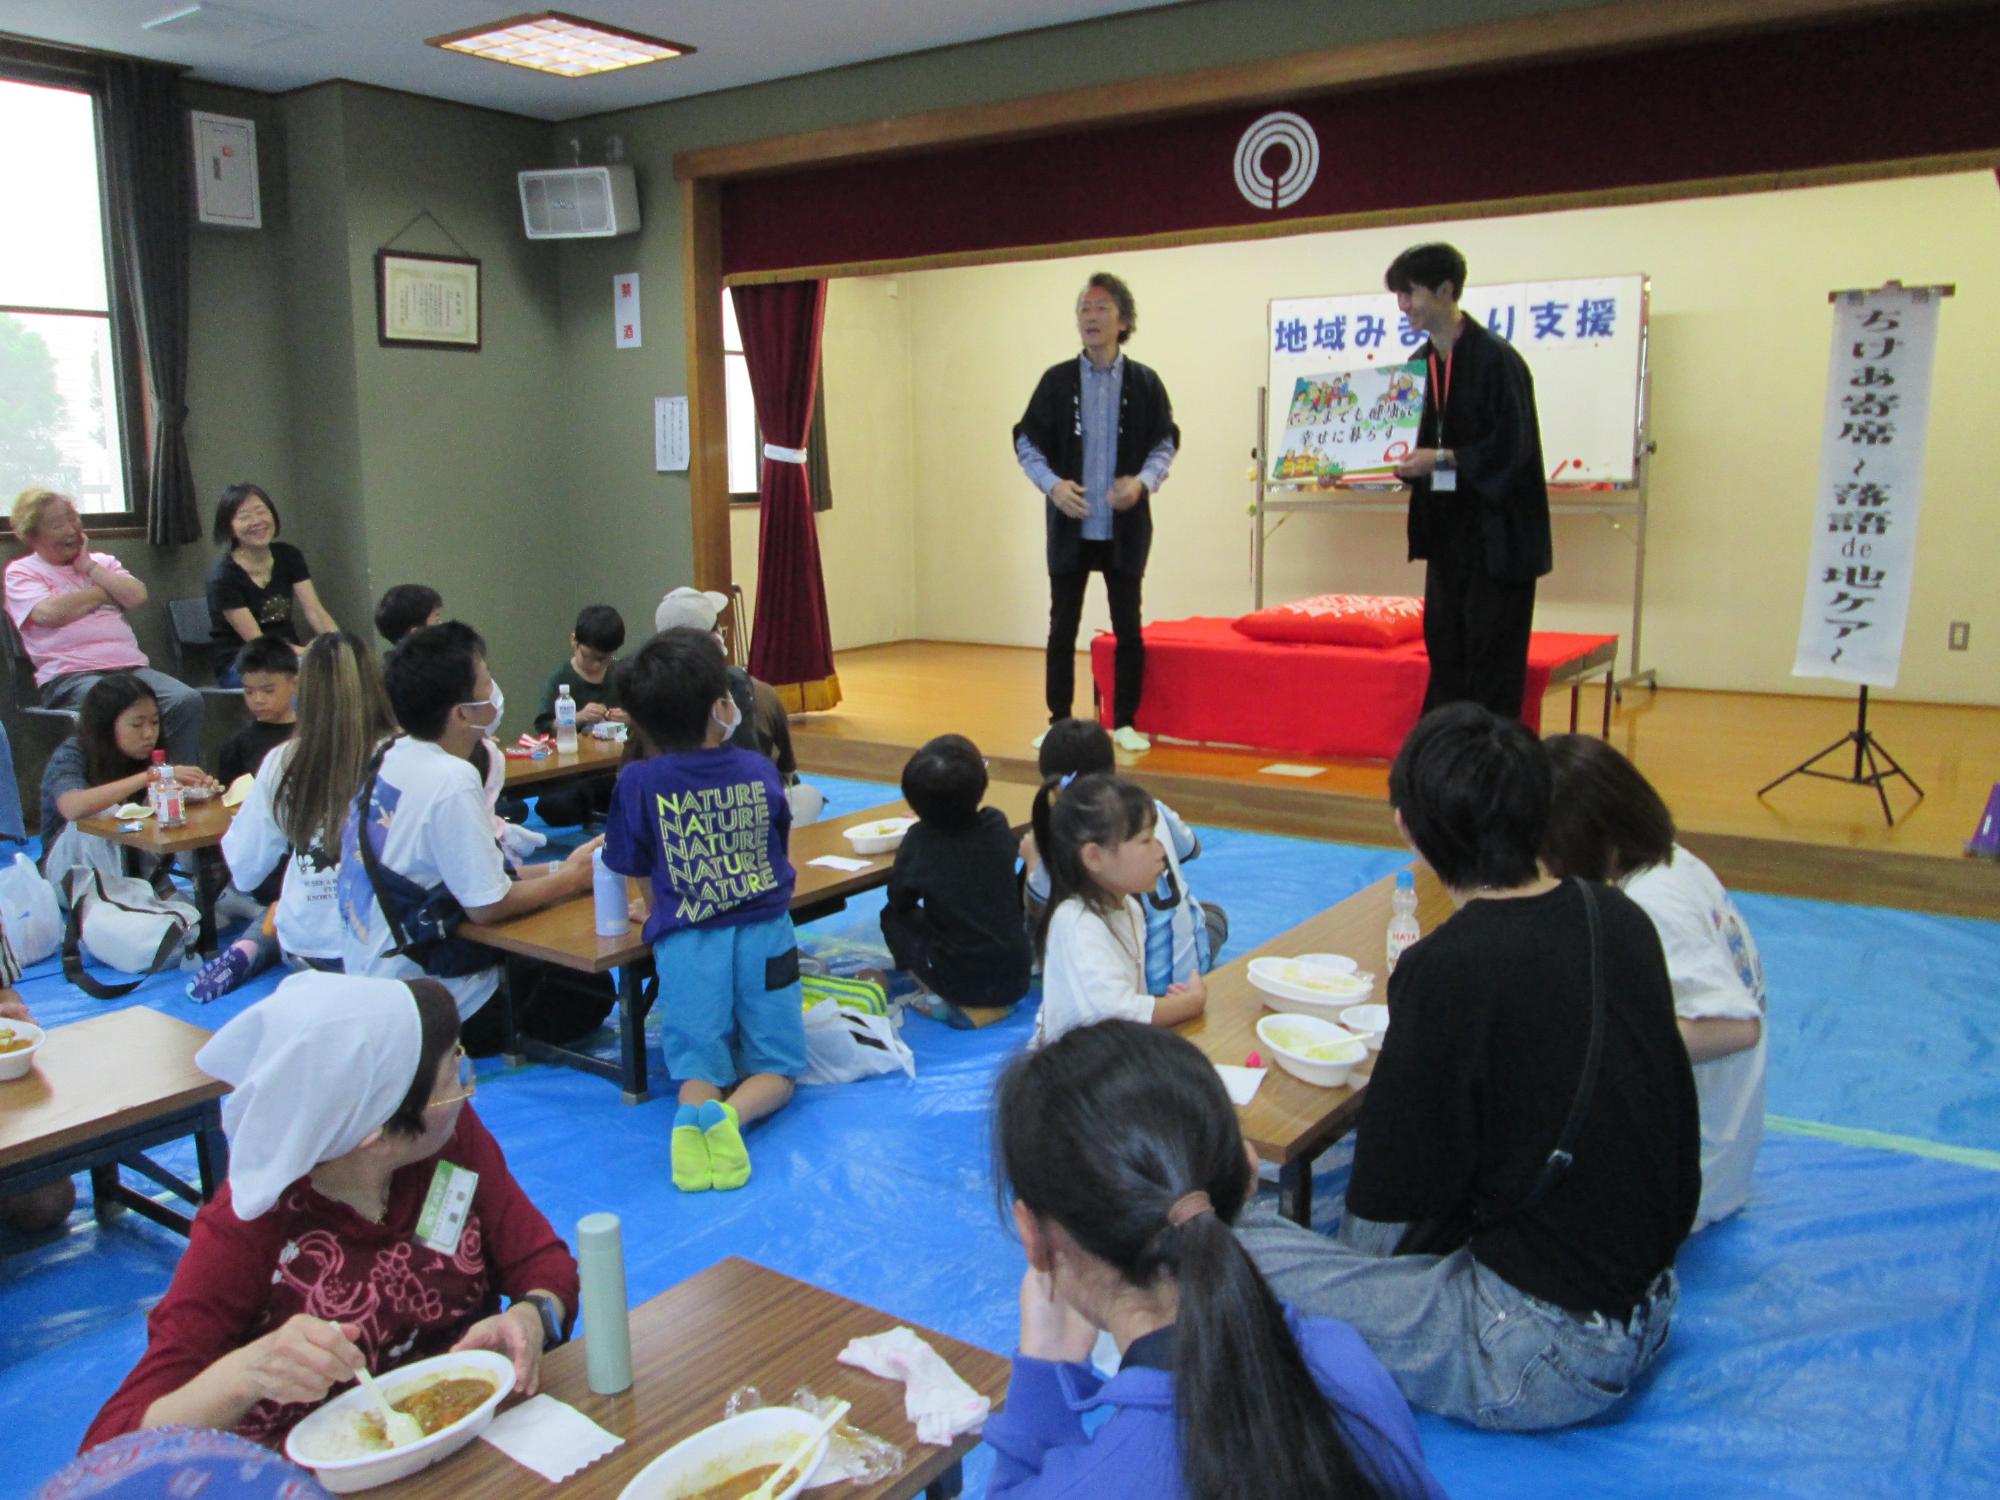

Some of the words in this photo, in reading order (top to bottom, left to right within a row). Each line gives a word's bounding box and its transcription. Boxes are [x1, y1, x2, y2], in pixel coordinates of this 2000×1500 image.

[1274, 298, 1616, 353] 地域みまり支援
[656, 781, 767, 816] NATURE
[659, 804, 769, 840] NATURE
[663, 826, 769, 863] NATURE
[668, 847, 770, 885] NATURE
